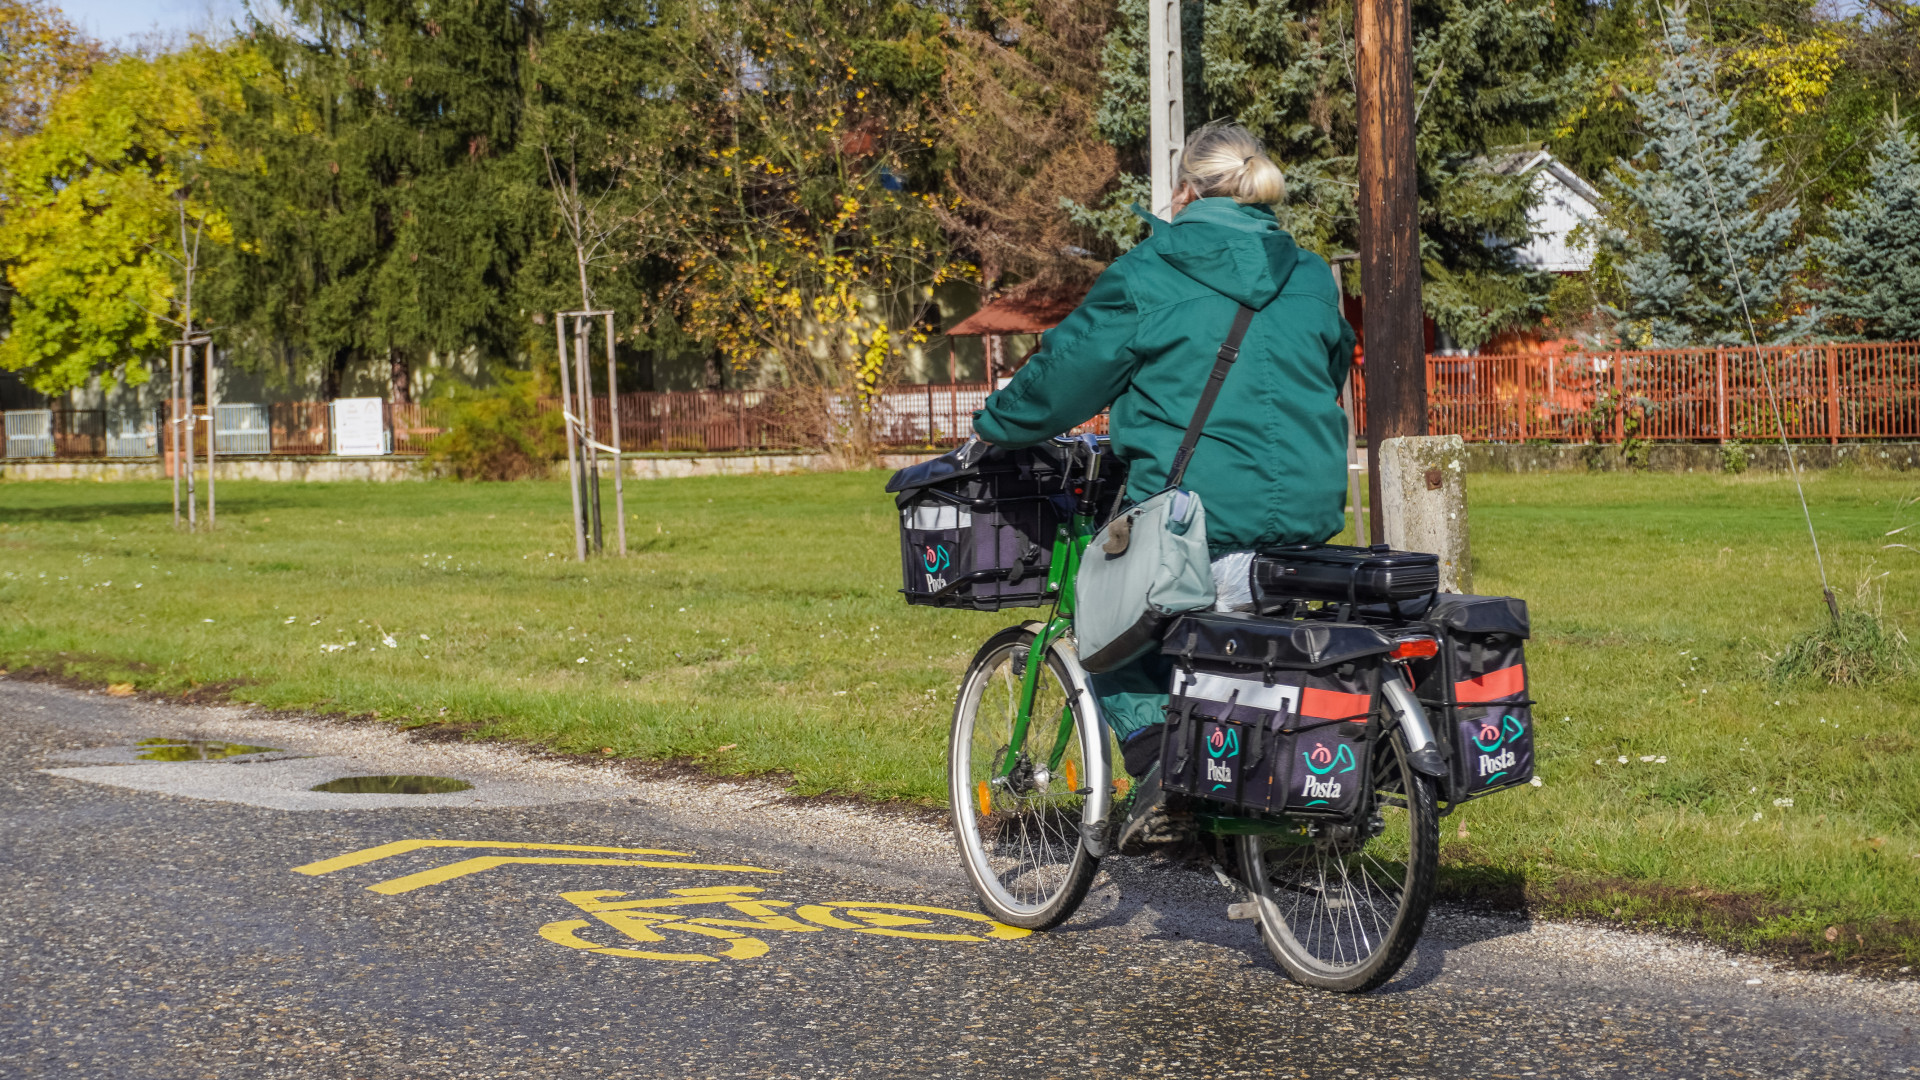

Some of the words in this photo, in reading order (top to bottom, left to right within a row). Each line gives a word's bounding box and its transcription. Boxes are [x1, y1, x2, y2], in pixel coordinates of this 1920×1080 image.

[1207, 758, 1232, 783] Posta
[1479, 748, 1516, 776] Posta
[1301, 774, 1342, 798] Posta
